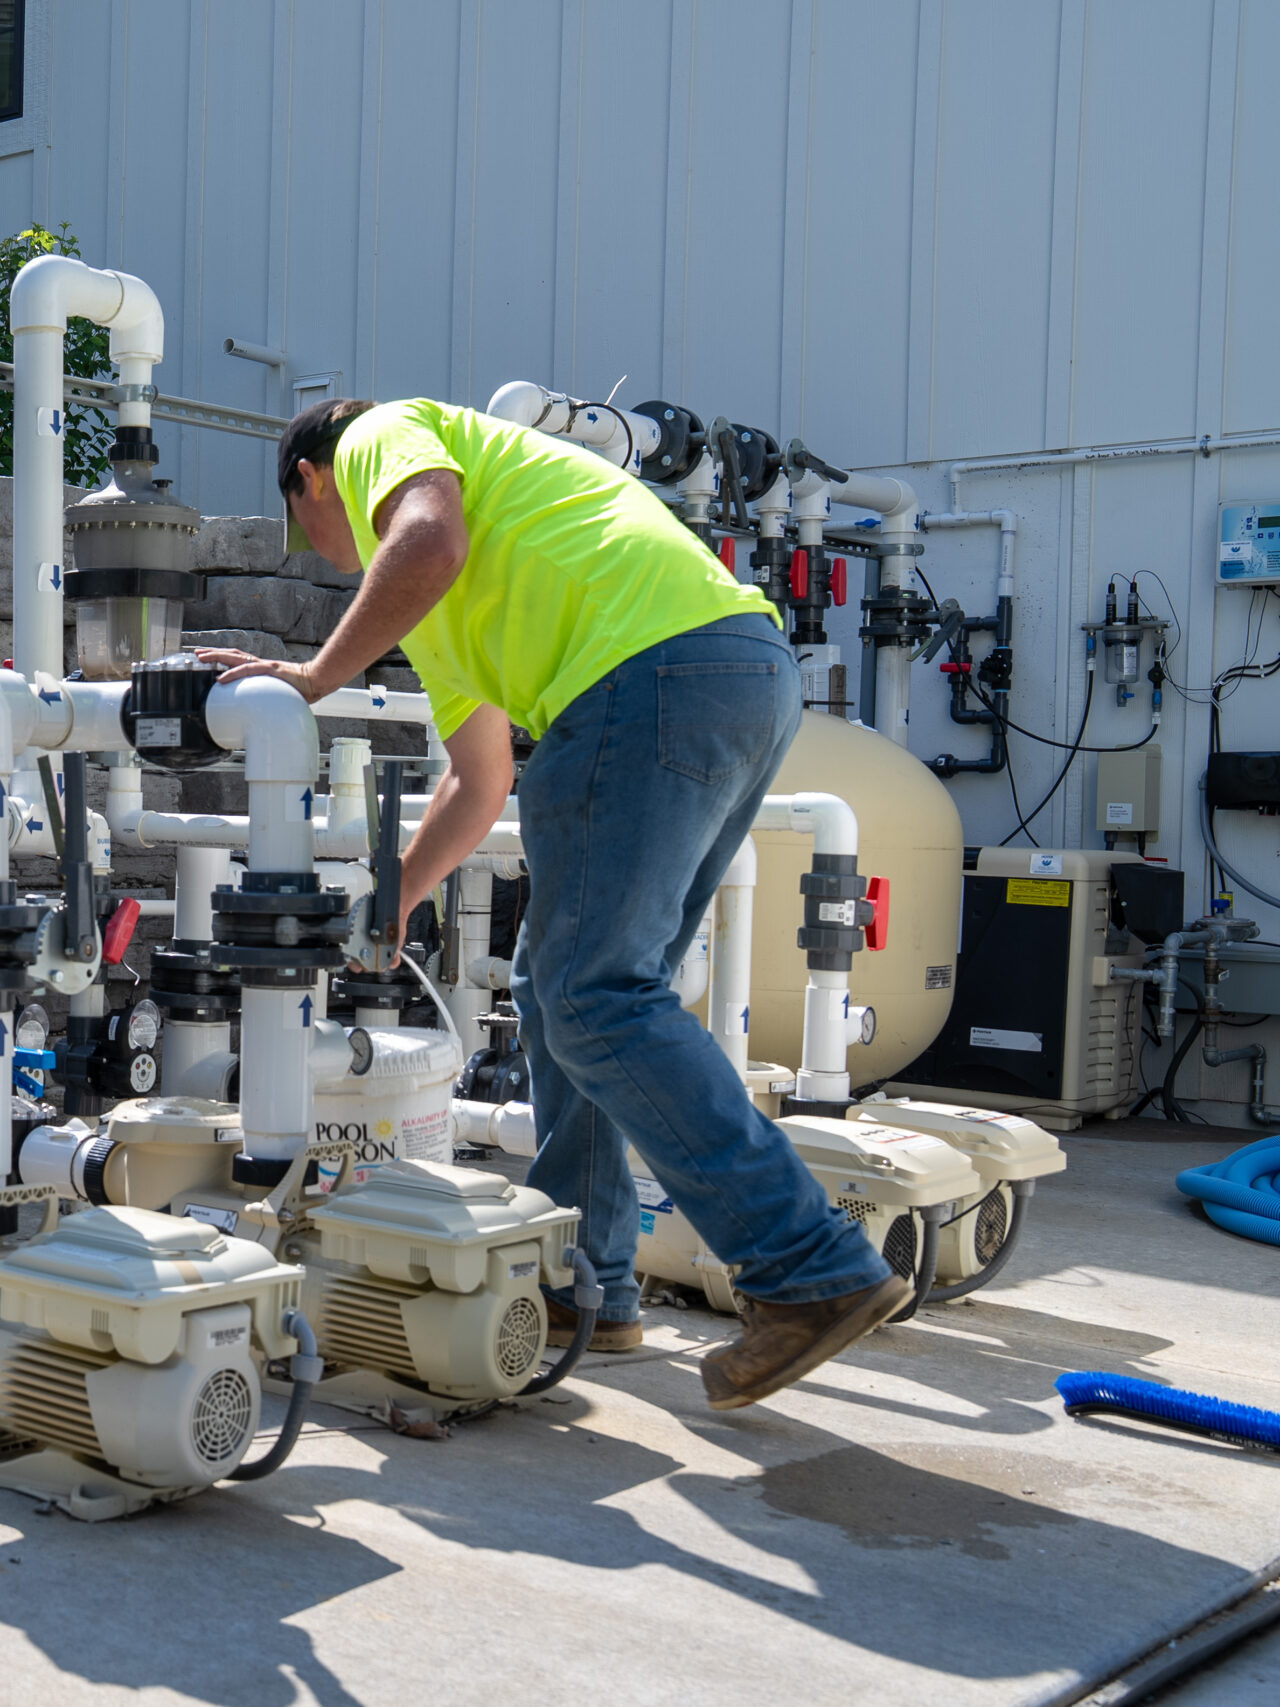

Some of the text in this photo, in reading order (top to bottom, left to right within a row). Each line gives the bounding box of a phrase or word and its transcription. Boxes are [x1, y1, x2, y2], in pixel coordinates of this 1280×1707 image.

[401, 1112, 441, 1128] ALKALINITY
[316, 1122, 373, 1142] POOL
[318, 1141, 395, 1163] SON
